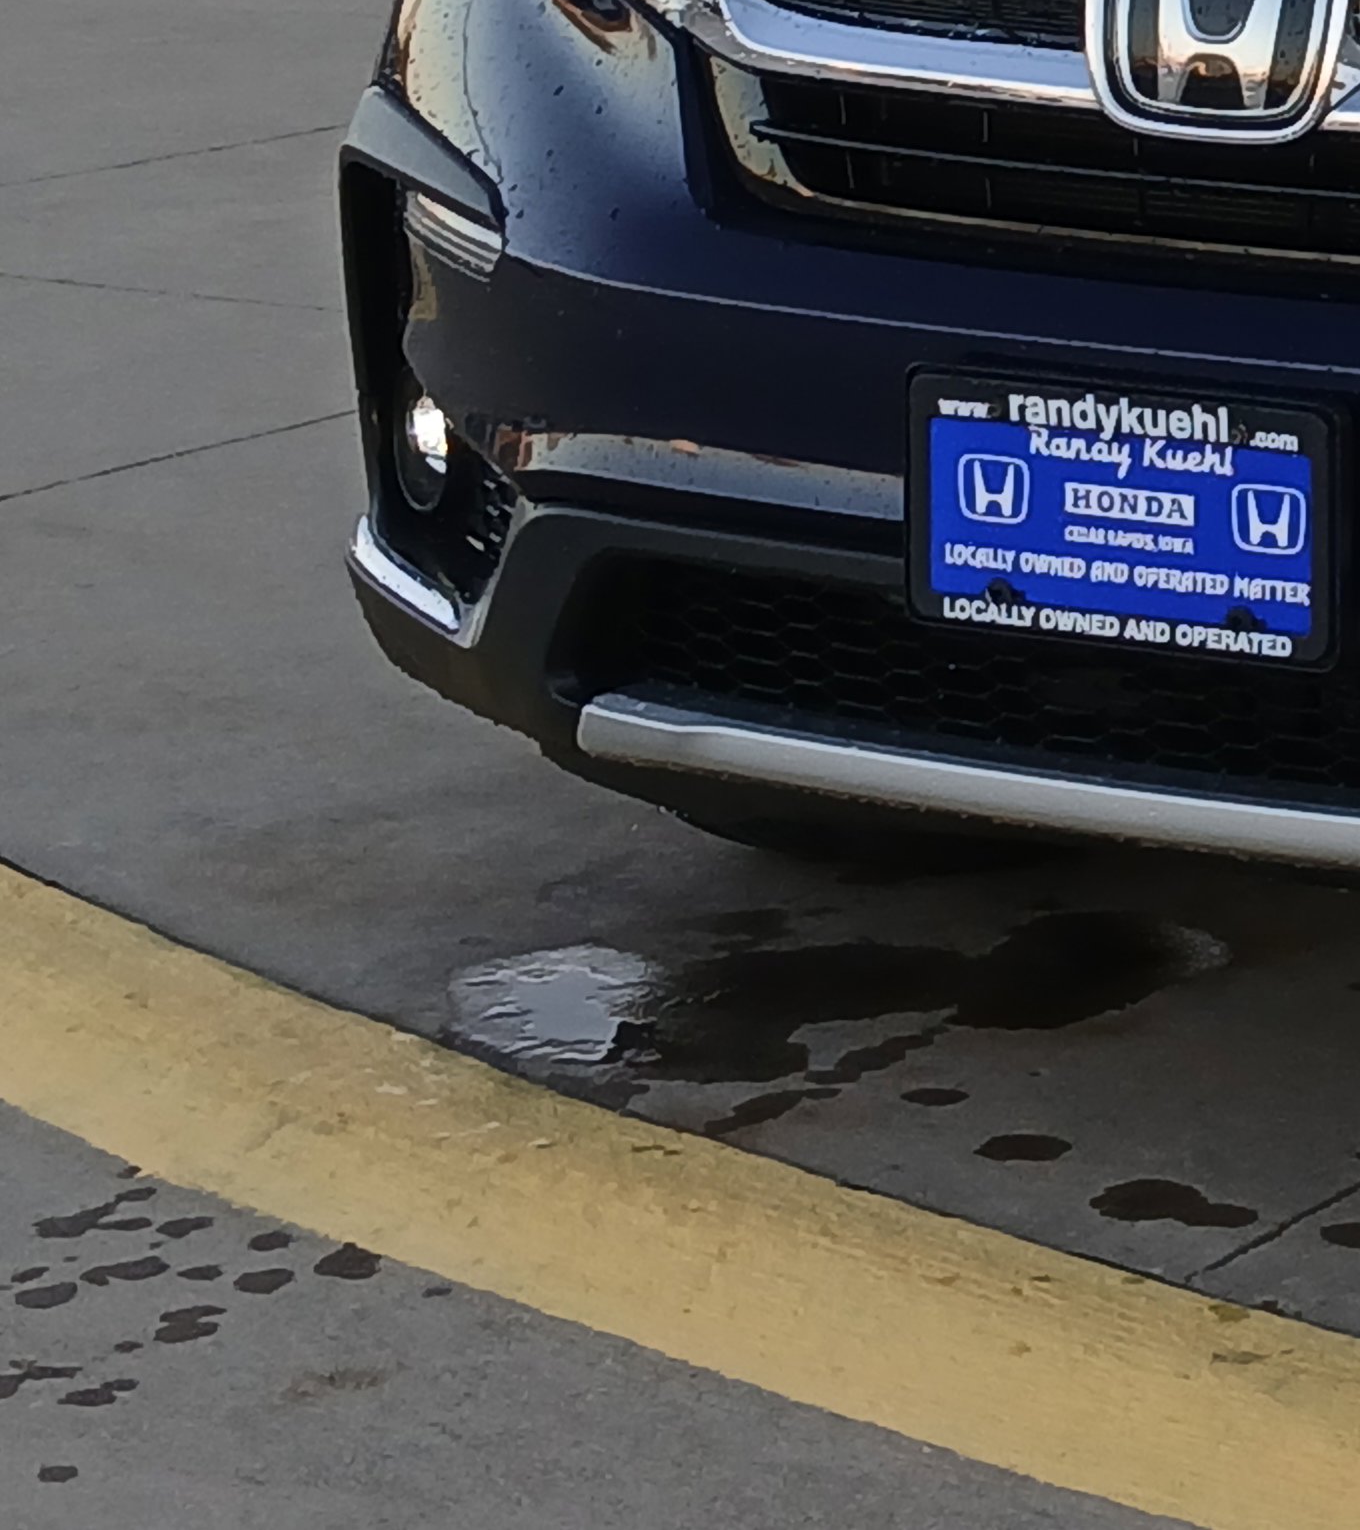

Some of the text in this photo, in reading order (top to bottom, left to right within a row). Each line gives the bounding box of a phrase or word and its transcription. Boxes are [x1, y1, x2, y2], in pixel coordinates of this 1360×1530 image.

[1008, 393, 1230, 443] randykuehl
[1250, 431, 1299, 452] .com
[1143, 438, 1235, 477] Kuehl
[1071, 487, 1189, 520] HONDA
[945, 542, 1016, 572] LOCALLY
[1019, 552, 1086, 579] OWNED
[1090, 560, 1129, 584] AND
[1133, 566, 1229, 595] OPERATED
[943, 596, 1293, 657] LOCALLY OWNED AND OPERATED
